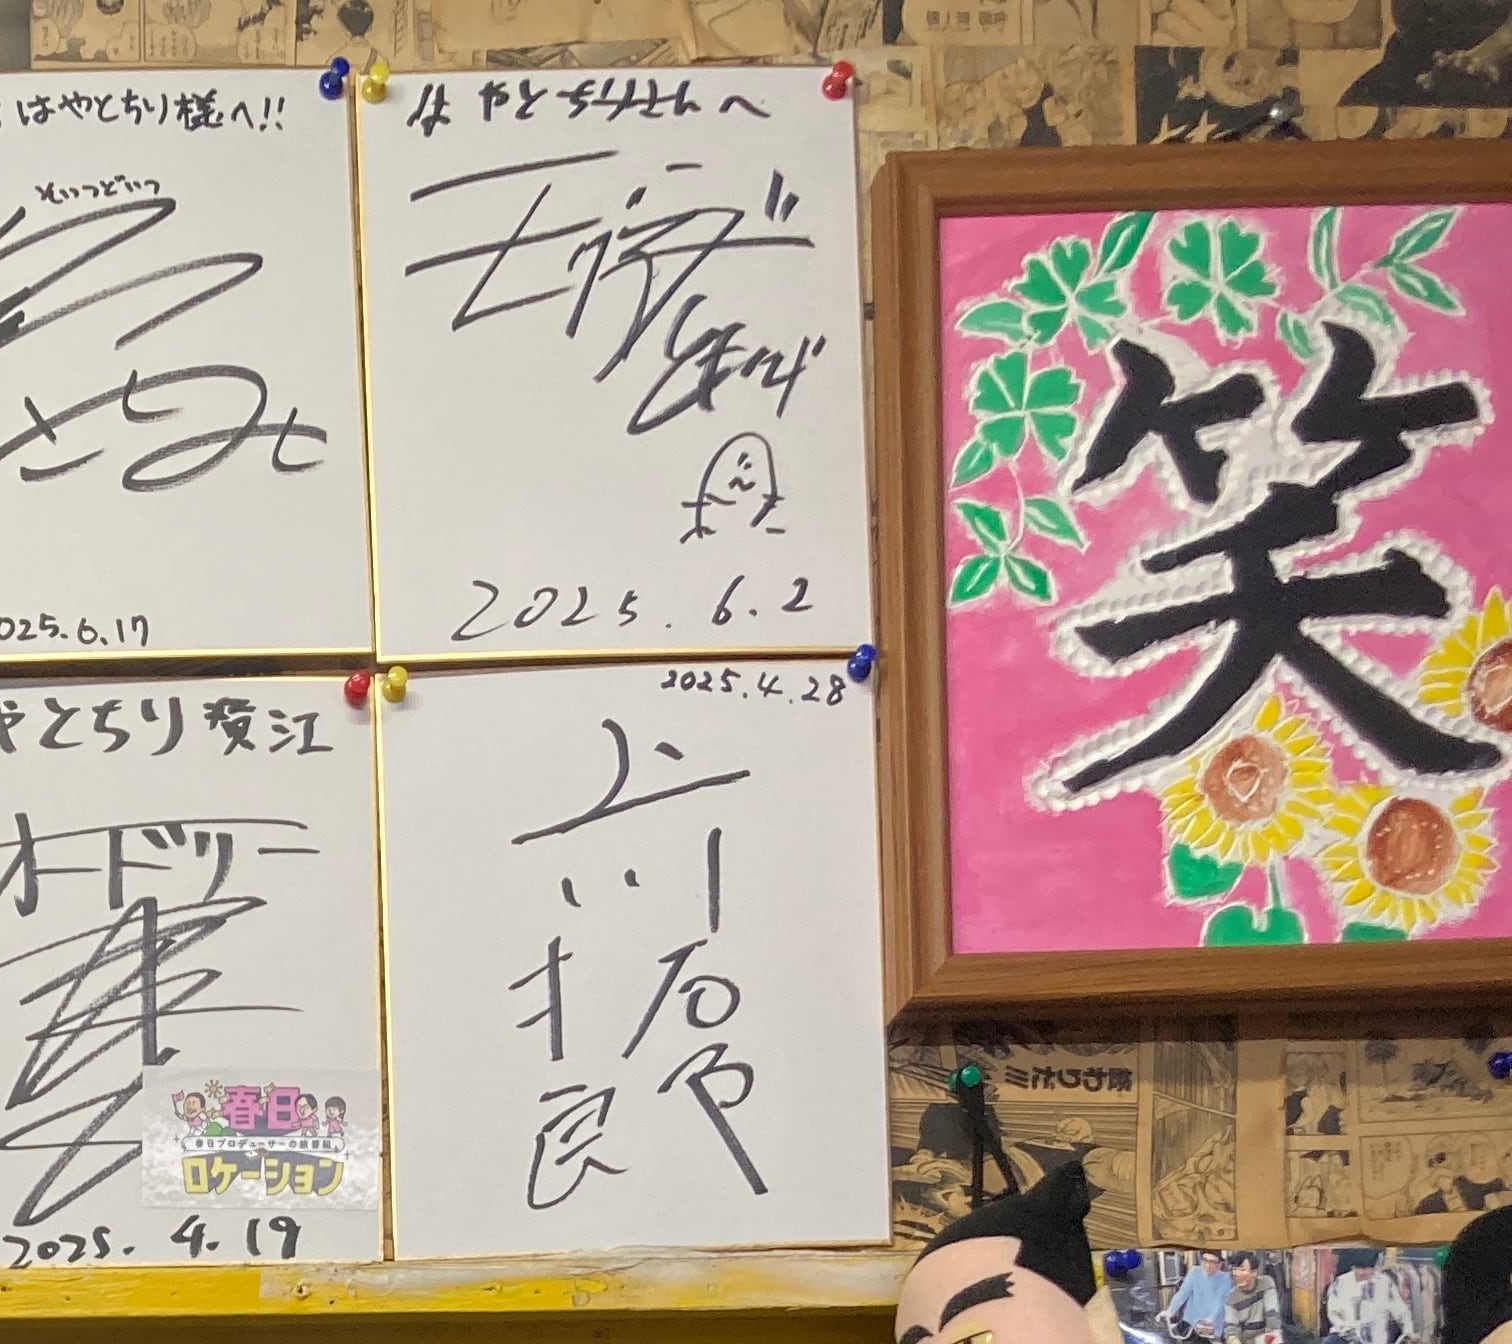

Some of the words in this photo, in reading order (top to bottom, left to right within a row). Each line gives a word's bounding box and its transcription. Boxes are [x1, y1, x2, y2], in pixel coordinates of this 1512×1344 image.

[1061, 321, 1501, 794] 笑
[221, 1085, 301, 1131] 春日
[182, 1154, 345, 1196] ロケーション
